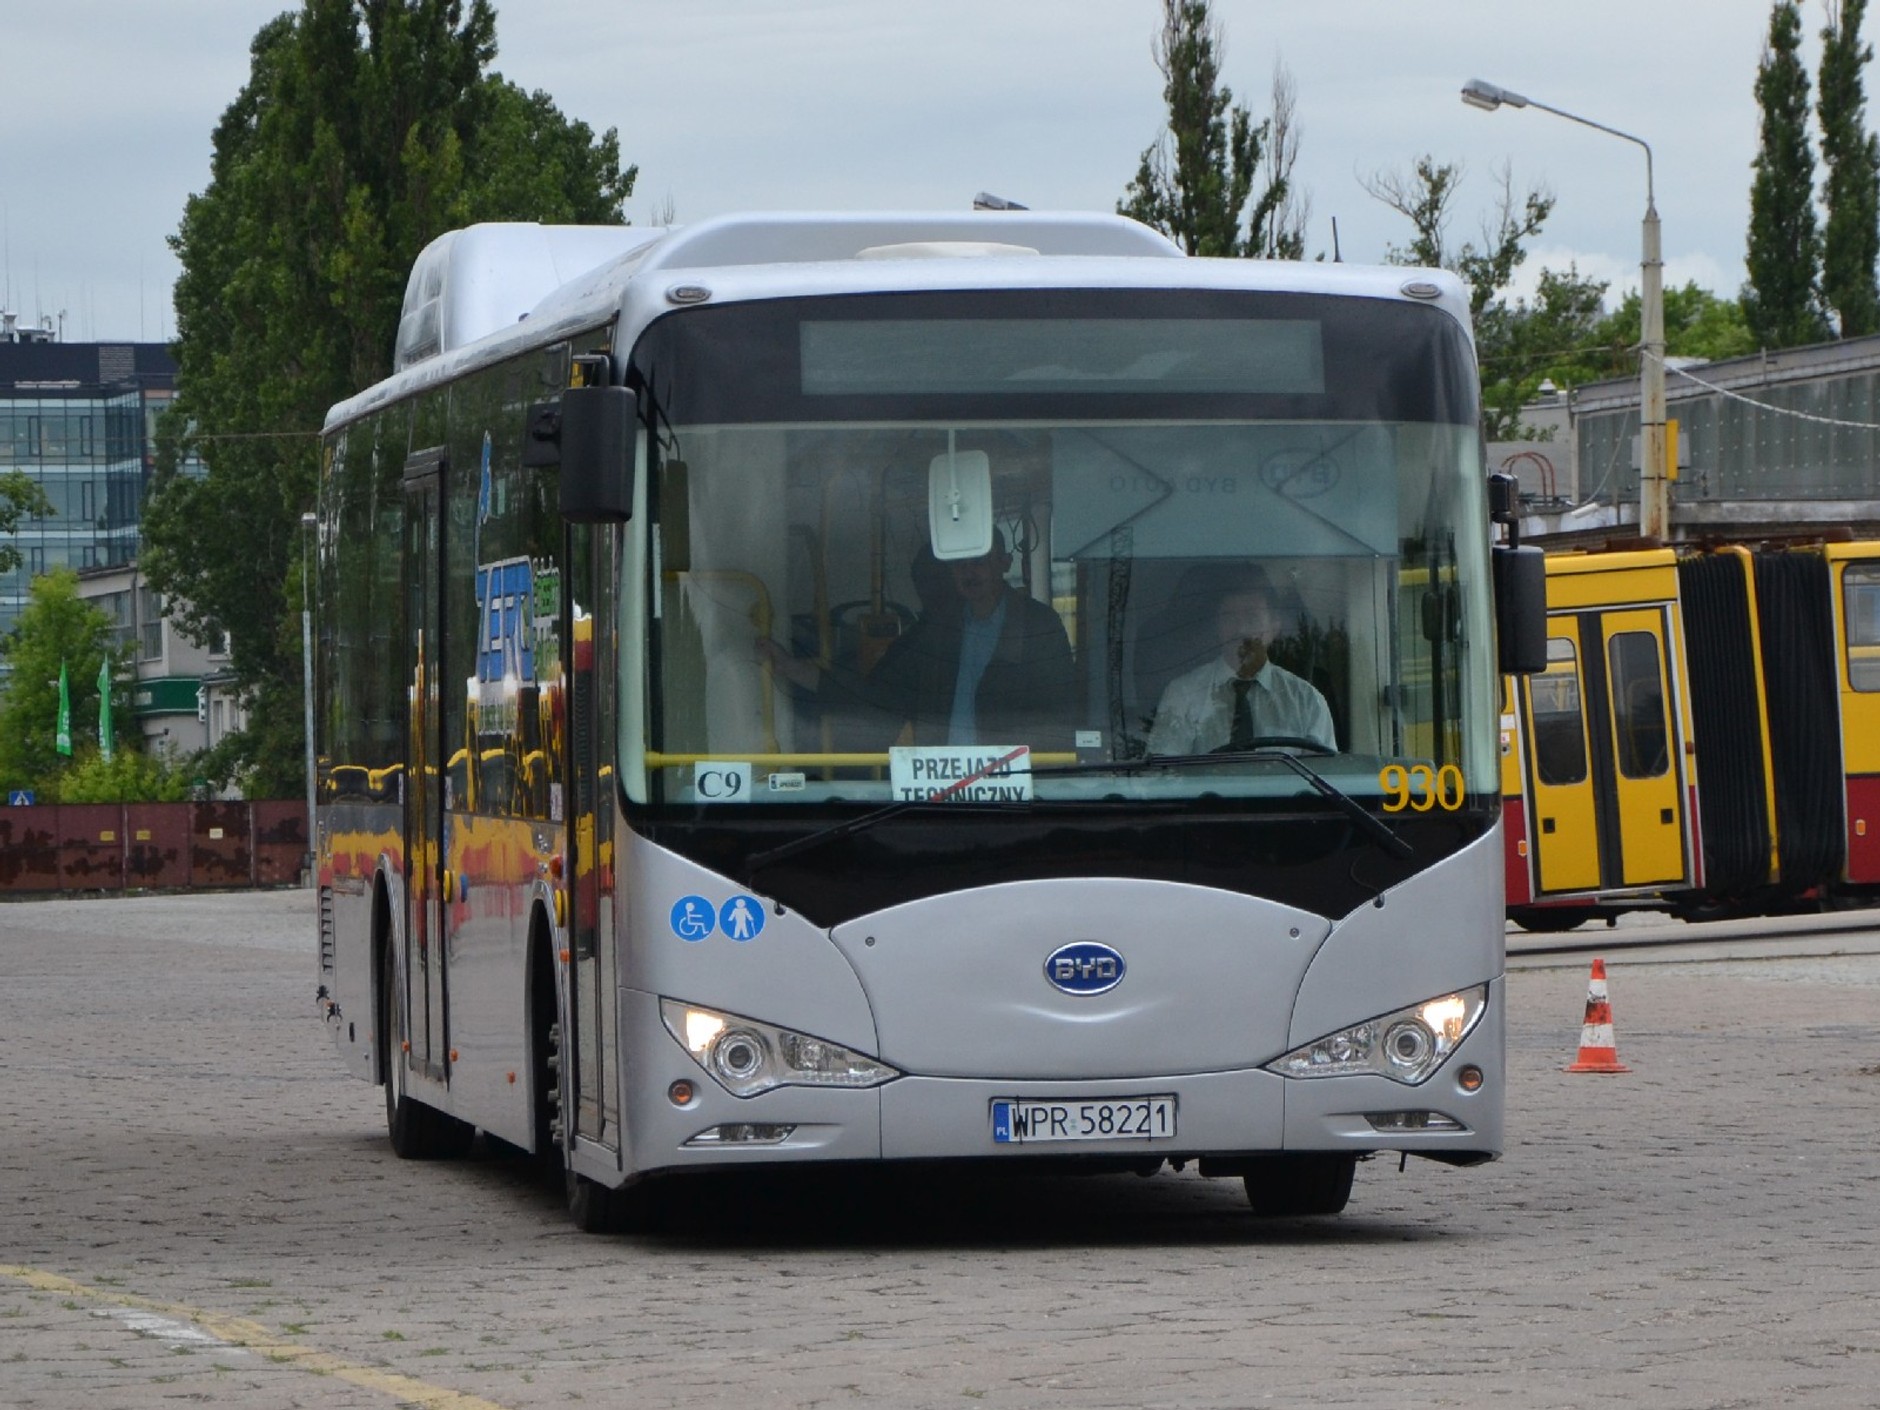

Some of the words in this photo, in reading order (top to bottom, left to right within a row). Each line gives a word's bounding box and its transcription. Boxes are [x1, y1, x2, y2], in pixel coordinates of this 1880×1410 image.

[911, 756, 1012, 781] PRZEJAZD
[697, 770, 742, 798] C9
[1379, 764, 1465, 812] 930
[1054, 957, 1117, 980] BYD
[996, 1126, 1009, 1137] PL
[1011, 1106, 1069, 1138] WPR
[1080, 1103, 1167, 1135] 58221
